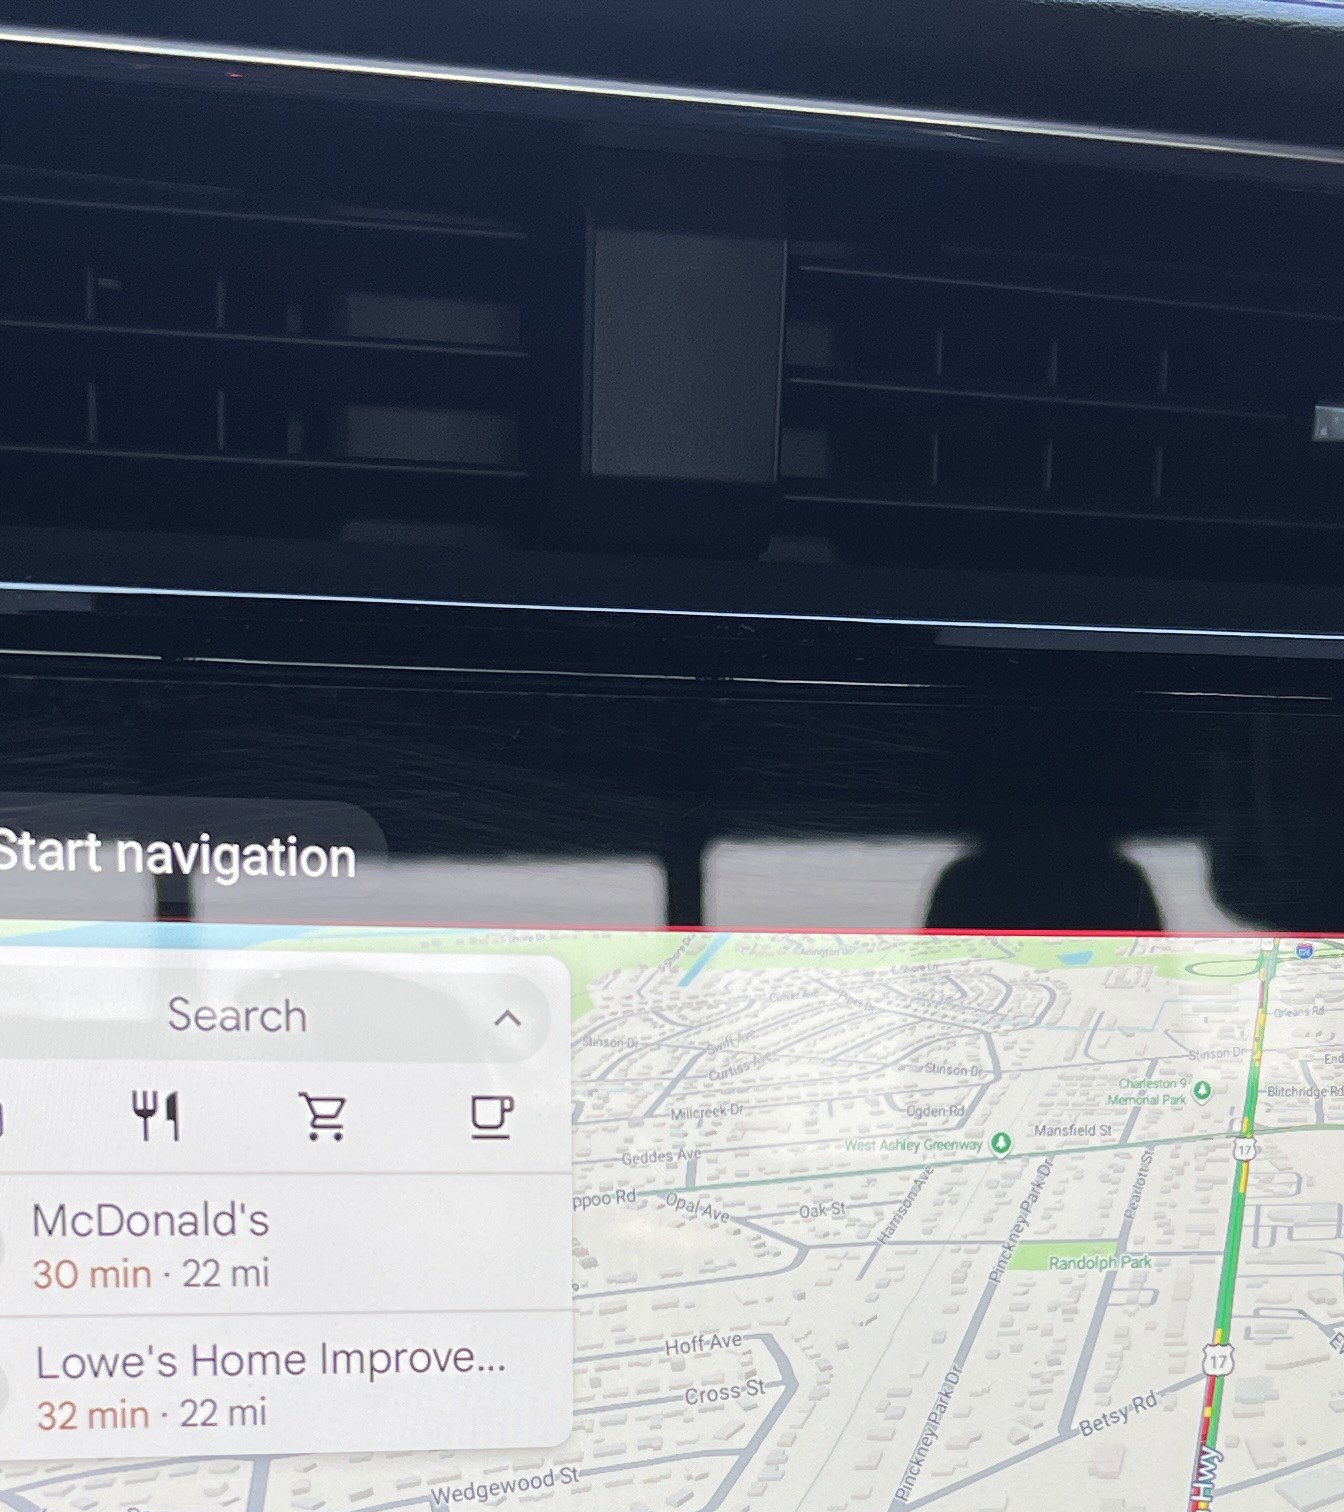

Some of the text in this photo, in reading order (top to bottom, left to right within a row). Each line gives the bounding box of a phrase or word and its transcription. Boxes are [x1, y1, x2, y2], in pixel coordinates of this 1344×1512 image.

[117, 832, 356, 886] navigation
[168, 996, 307, 1033] Search
[1324, 1053, 1343, 1065] End
[1118, 1077, 1187, 1089] Charleston 9
[1267, 1085, 1344, 1099] Blitchridge Rd
[906, 1104, 966, 1119] Ogden Rd
[1107, 1094, 1187, 1106] Memorial Park
[1034, 1123, 1113, 1137] Mansfield St
[622, 1147, 702, 1166] Geddes Ave
[879, 1138, 921, 1154] Ashley
[924, 1138, 983, 1154] Greenway
[1239, 1145, 1252, 1156] 17
[615, 1189, 636, 1204] Rd
[666, 1192, 730, 1224] Opal Ave
[877, 1164, 935, 1245] Harrison Ave
[32, 1200, 270, 1238] McDonald's
[799, 1202, 846, 1219] Oak St
[989, 1156, 1055, 1283] Pinckney Park Dr
[33, 1256, 270, 1289] 30 min 22 mi
[1049, 1254, 1153, 1273] Randolph Park
[665, 1333, 743, 1356] Hoff Ave
[36, 1345, 178, 1379] Lowe's
[192, 1343, 307, 1377] Home
[1209, 1354, 1228, 1369] 17
[685, 1378, 767, 1406] Cross St
[36, 1396, 267, 1431] 32 min 22 mi
[1079, 1390, 1158, 1437] Betsy Rd
[895, 1365, 965, 1502] Pinckney Park Dr
[431, 1466, 580, 1505] Wedgewood St
[1190, 1446, 1225, 1502] Hwy
